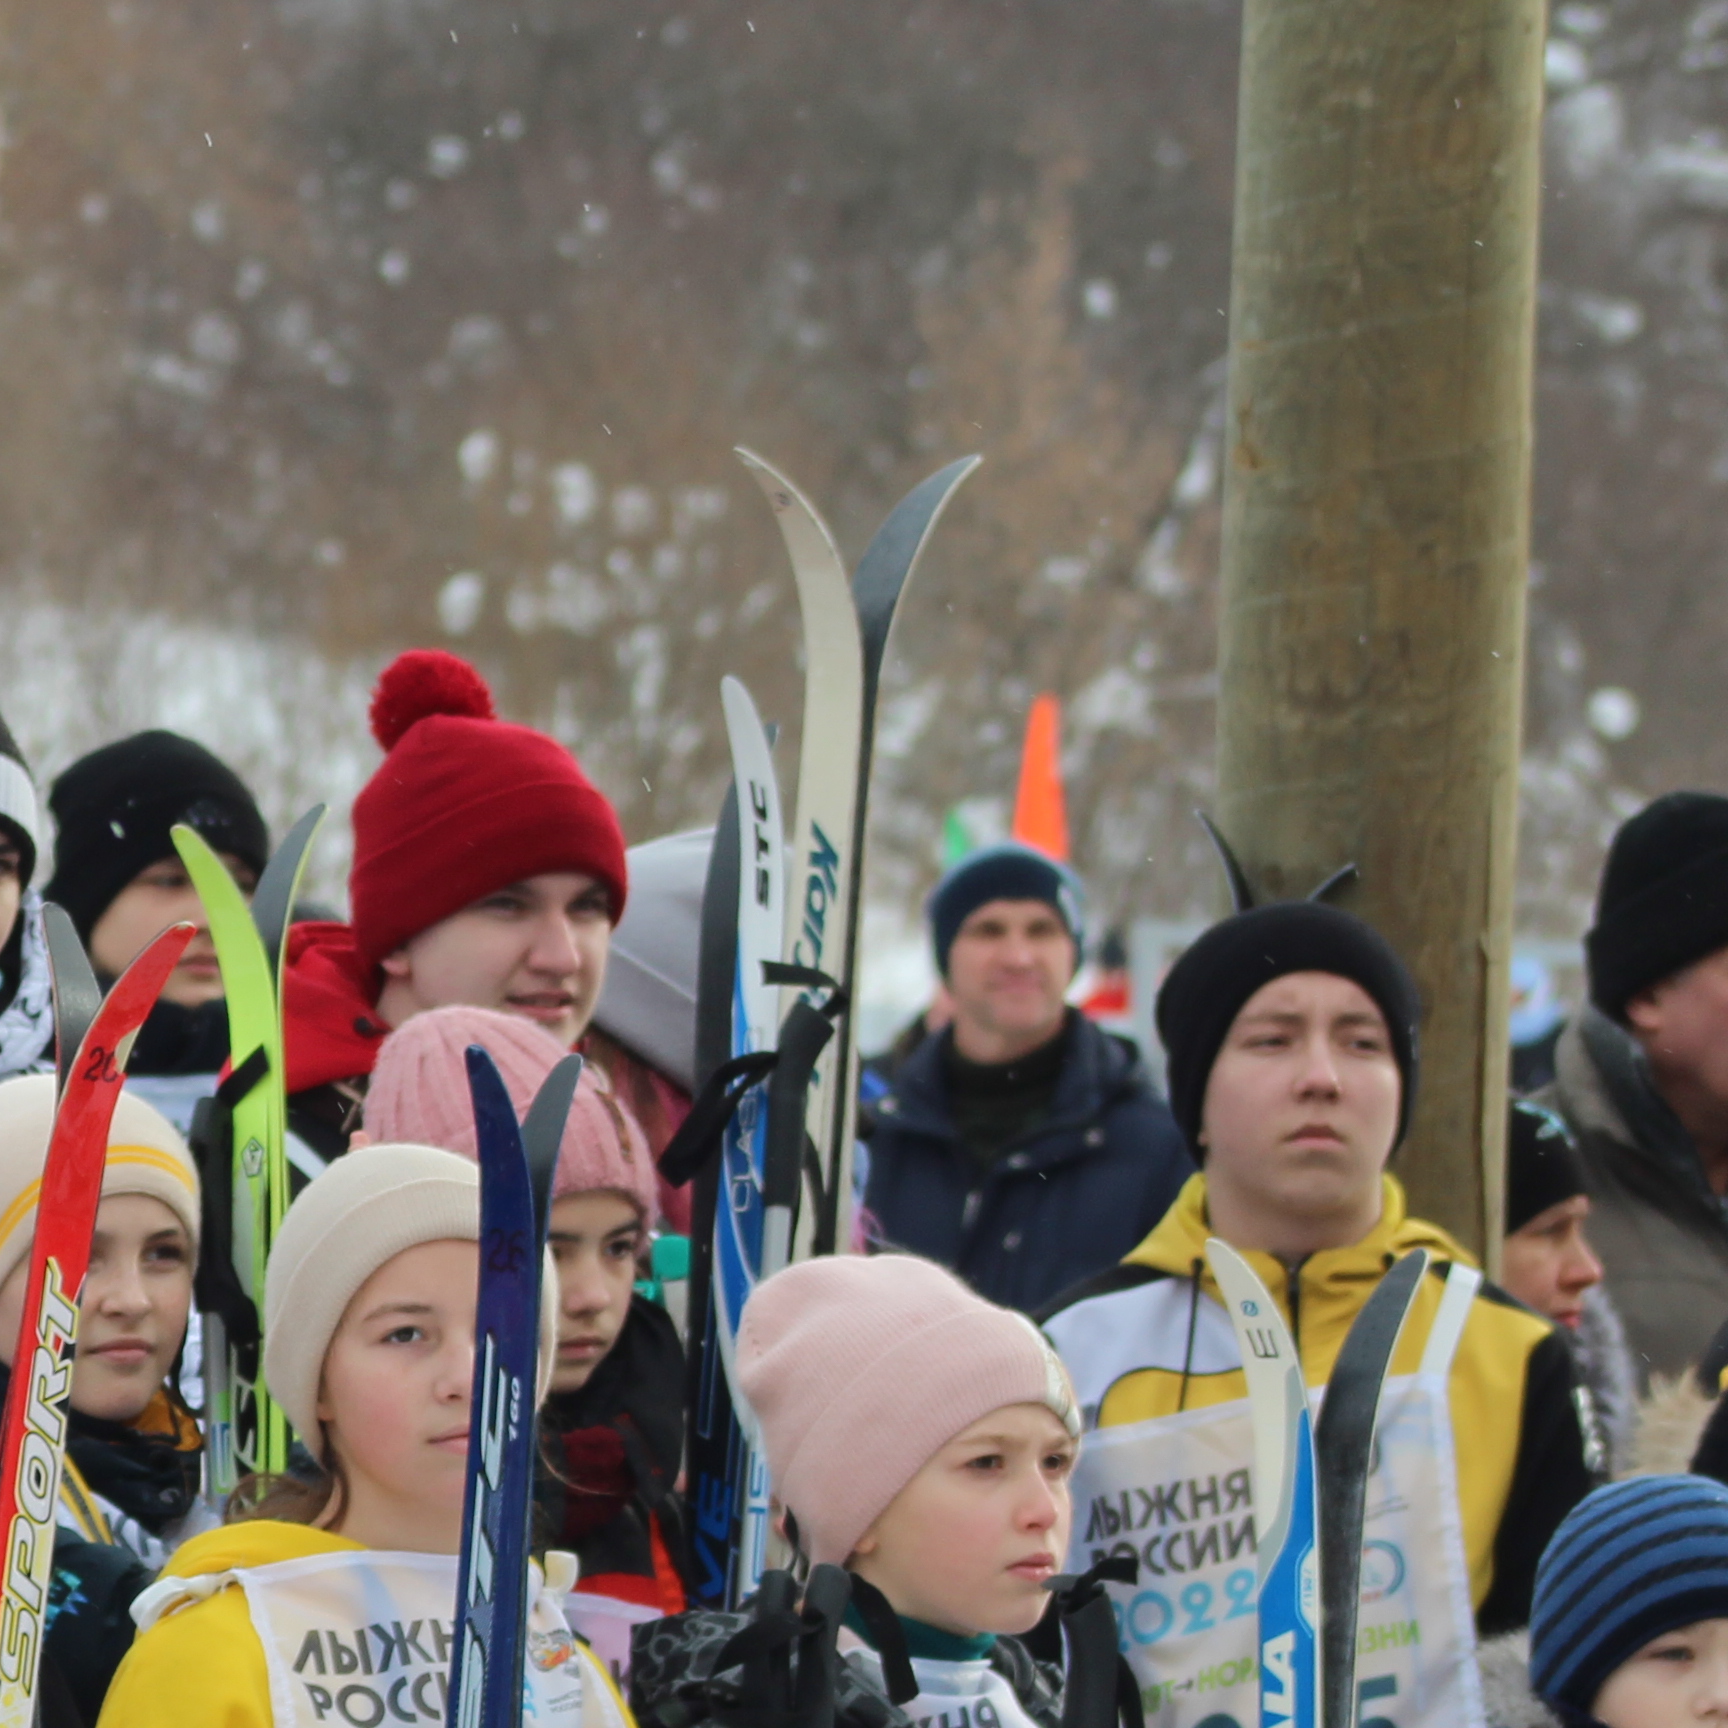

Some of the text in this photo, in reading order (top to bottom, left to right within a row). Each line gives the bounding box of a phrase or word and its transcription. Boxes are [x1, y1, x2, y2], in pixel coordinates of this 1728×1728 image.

[748, 778, 771, 910] STC
[508, 1376, 522, 1442] 160
[1083, 1467, 1252, 1544] ЛЫЖНЯ
[293, 1619, 454, 1677] ЛЫЖН
[1197, 1656, 1261, 1695] НОР
